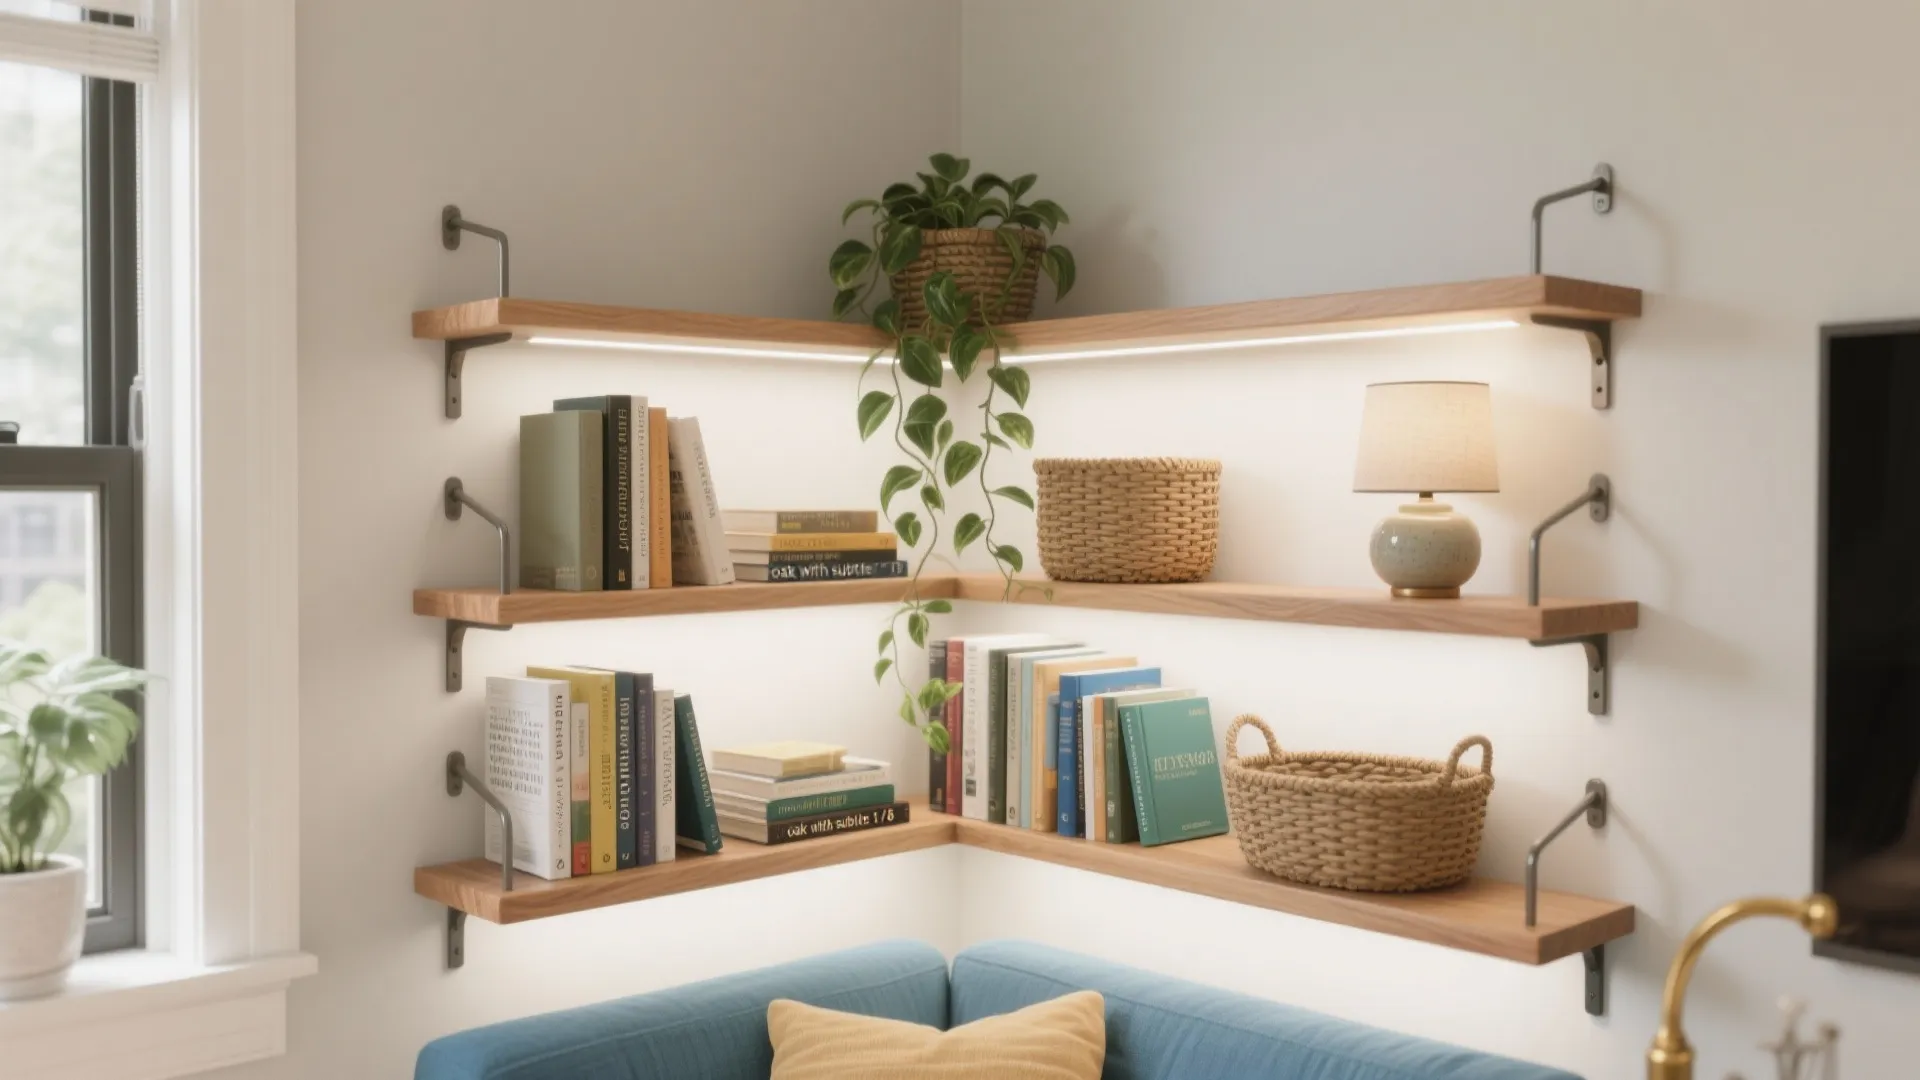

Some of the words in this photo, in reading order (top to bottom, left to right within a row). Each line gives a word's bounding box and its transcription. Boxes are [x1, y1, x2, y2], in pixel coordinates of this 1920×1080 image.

[772, 565, 796, 578] oak
[801, 563, 828, 577] with
[787, 821, 808, 837] oak
[811, 818, 833, 833] with
